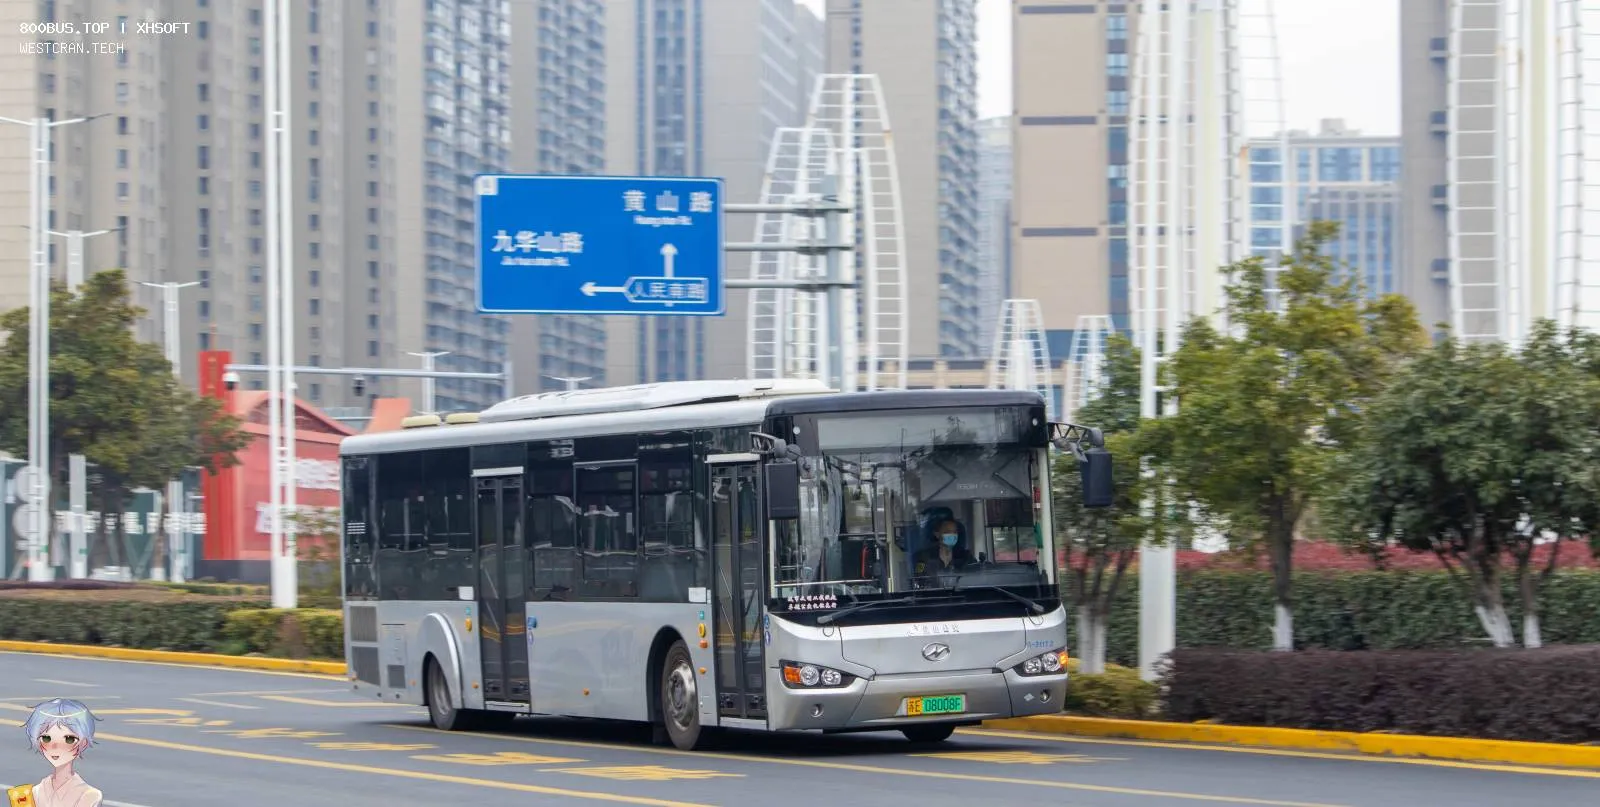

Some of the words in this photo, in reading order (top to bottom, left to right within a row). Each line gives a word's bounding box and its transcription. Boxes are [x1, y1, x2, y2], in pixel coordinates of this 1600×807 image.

[622, 189, 714, 213] 黄山路
[491, 229, 584, 253] 九华山路
